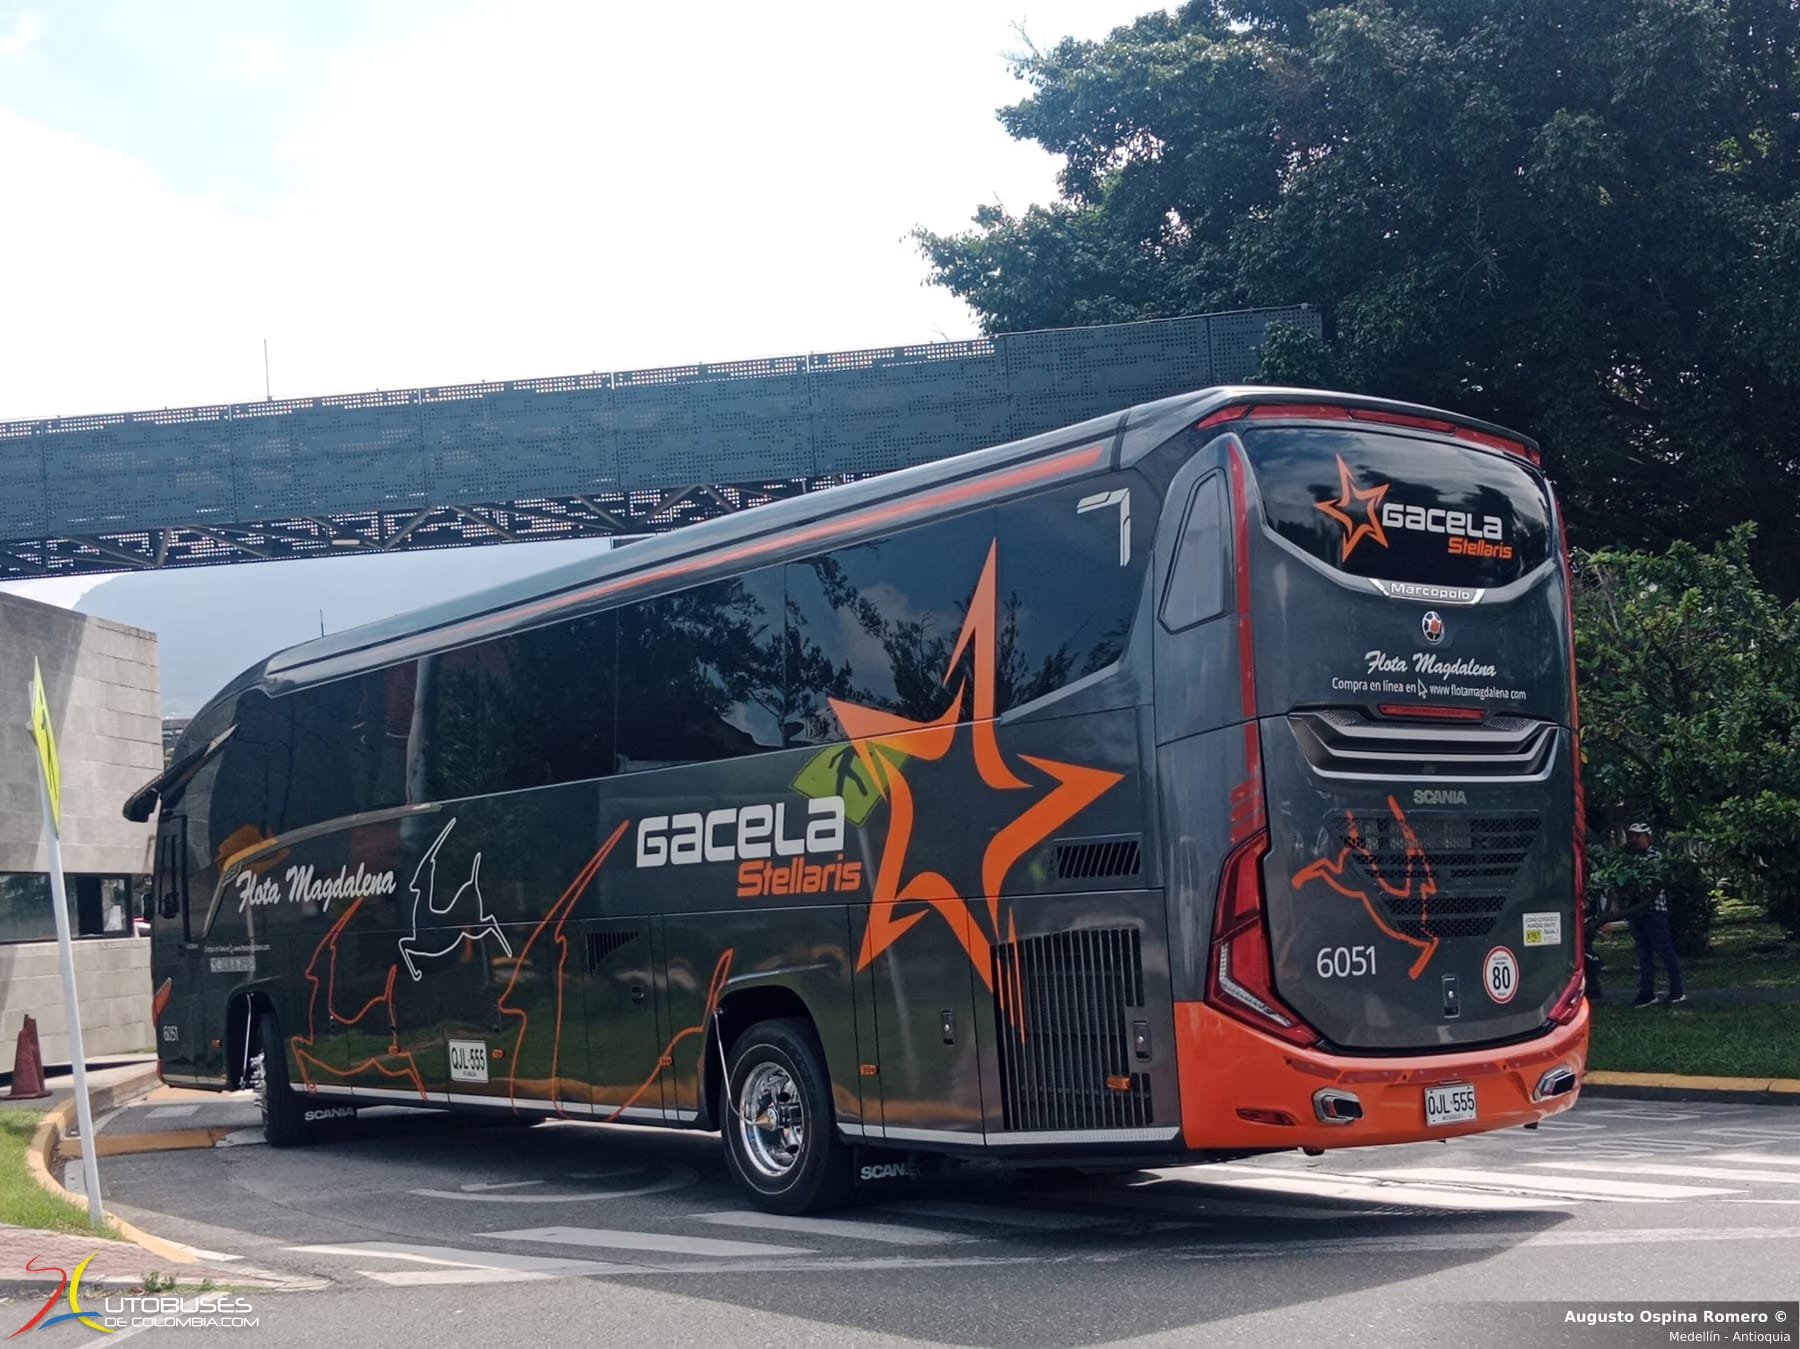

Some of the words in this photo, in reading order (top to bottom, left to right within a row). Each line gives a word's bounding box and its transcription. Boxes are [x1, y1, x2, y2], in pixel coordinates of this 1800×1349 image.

[1447, 536, 1513, 559] Stellaris
[1390, 583, 1471, 600] Marcopolo
[1364, 650, 1408, 675] Flota
[1412, 652, 1497, 680] Magdalena
[1332, 677, 1368, 694] Compra
[1369, 681, 1381, 692] en
[1405, 683, 1417, 693] en
[1413, 789, 1468, 805] SCANIA
[737, 853, 862, 897] Stellaris
[235, 869, 281, 913] Flota
[285, 862, 397, 912] Magdalena
[1316, 945, 1377, 978] 6051
[1492, 966, 1511, 989] 80
[860, 1163, 906, 1180] SCAN
